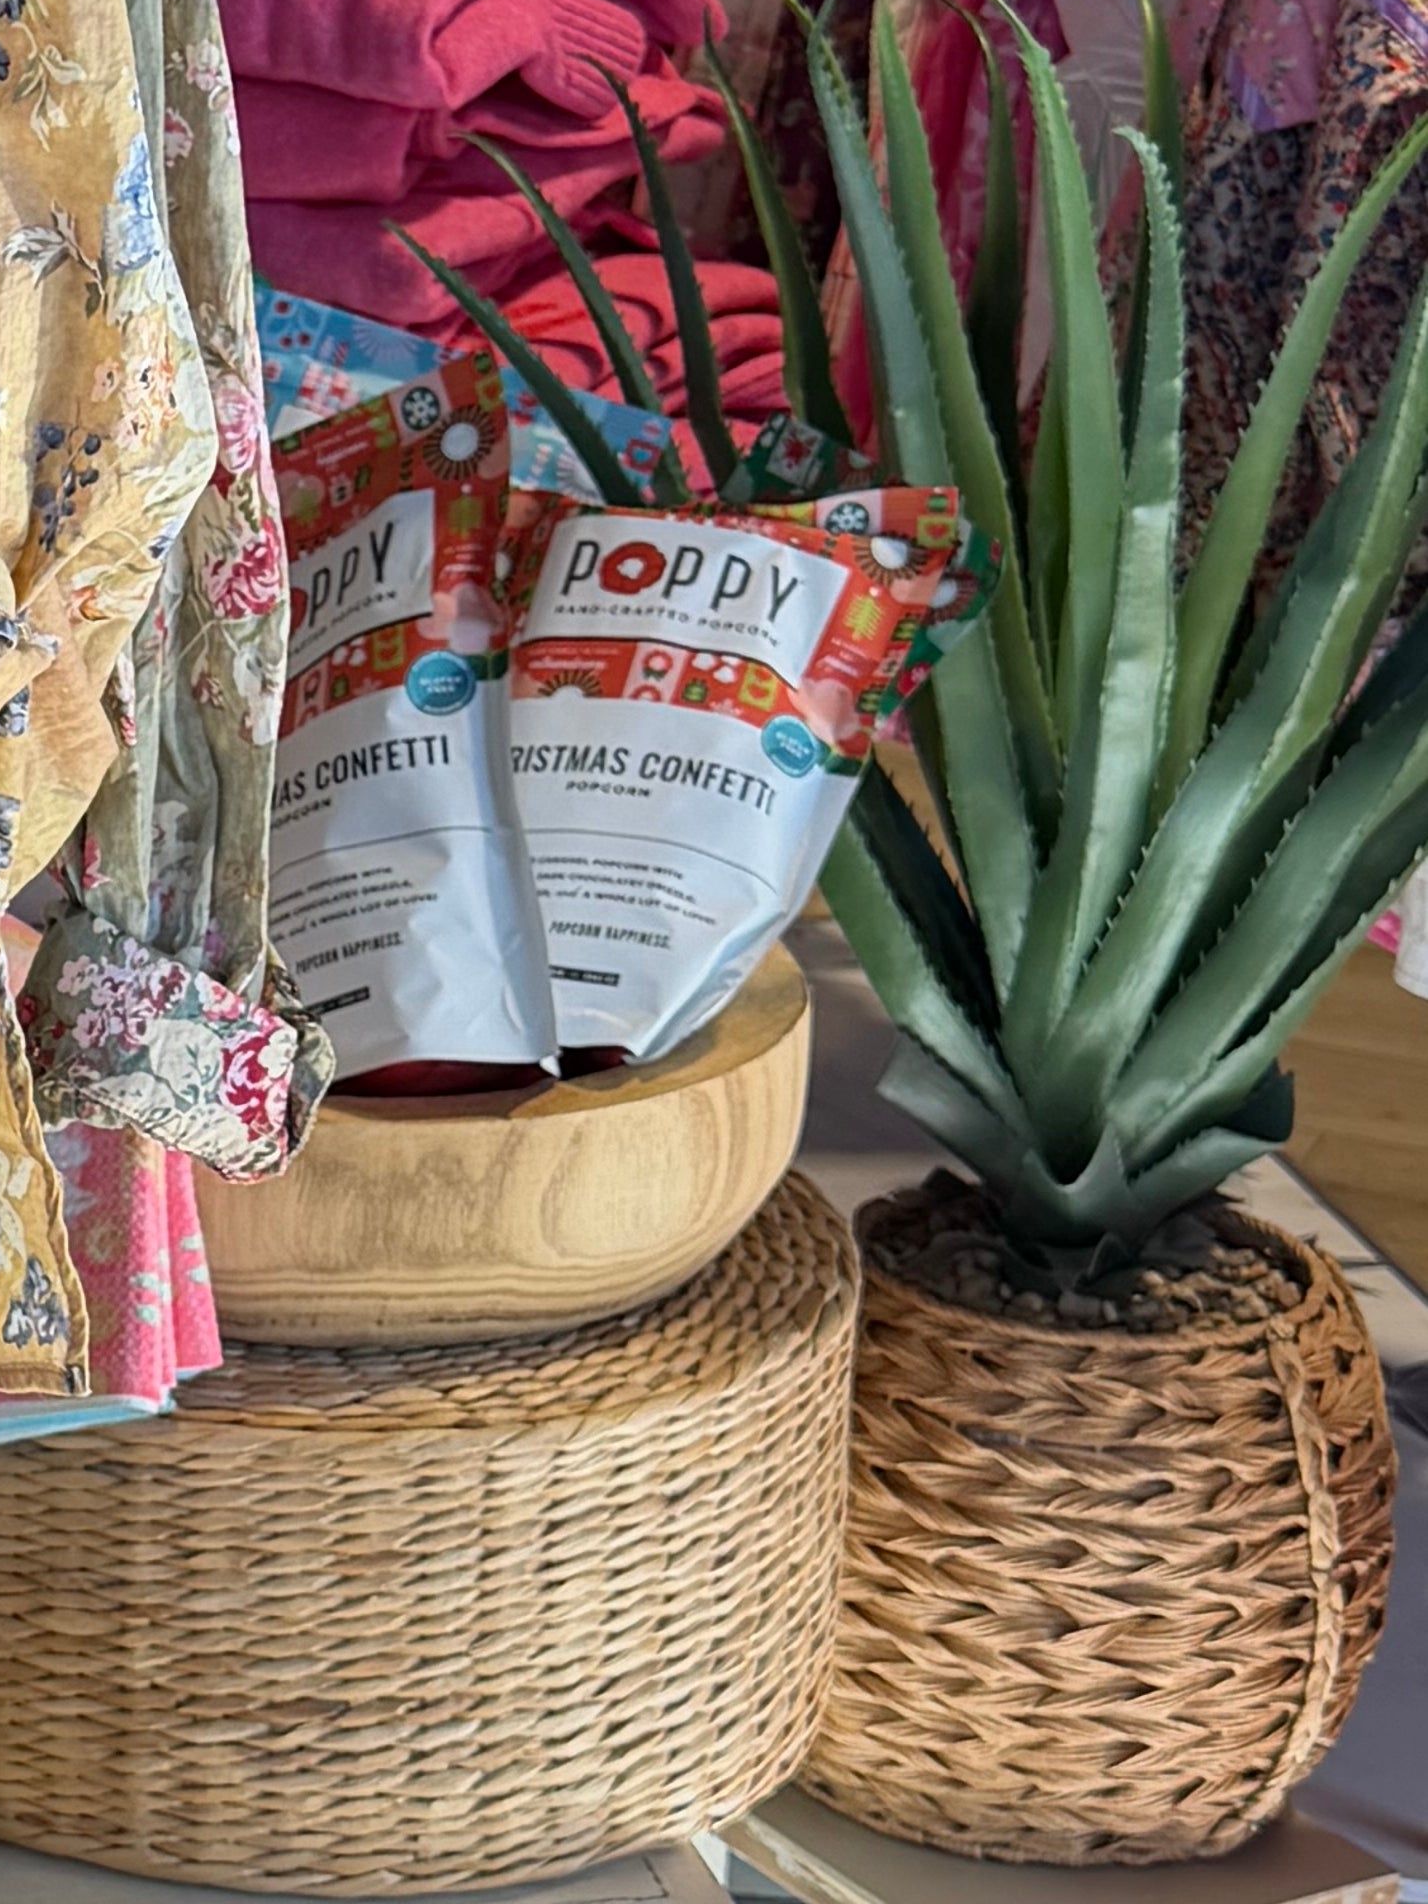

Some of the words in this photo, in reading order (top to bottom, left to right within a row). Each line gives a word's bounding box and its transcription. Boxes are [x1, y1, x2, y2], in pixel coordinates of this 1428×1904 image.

[561, 539, 799, 624] POPPY
[316, 734, 450, 791] CONFETTI
[510, 745, 630, 776] RISTMAS
[639, 752, 778, 816] CONFETTI
[565, 780, 651, 798] POPCORN
[549, 920, 602, 939] POPCORN
[295, 948, 339, 975] POPCORN
